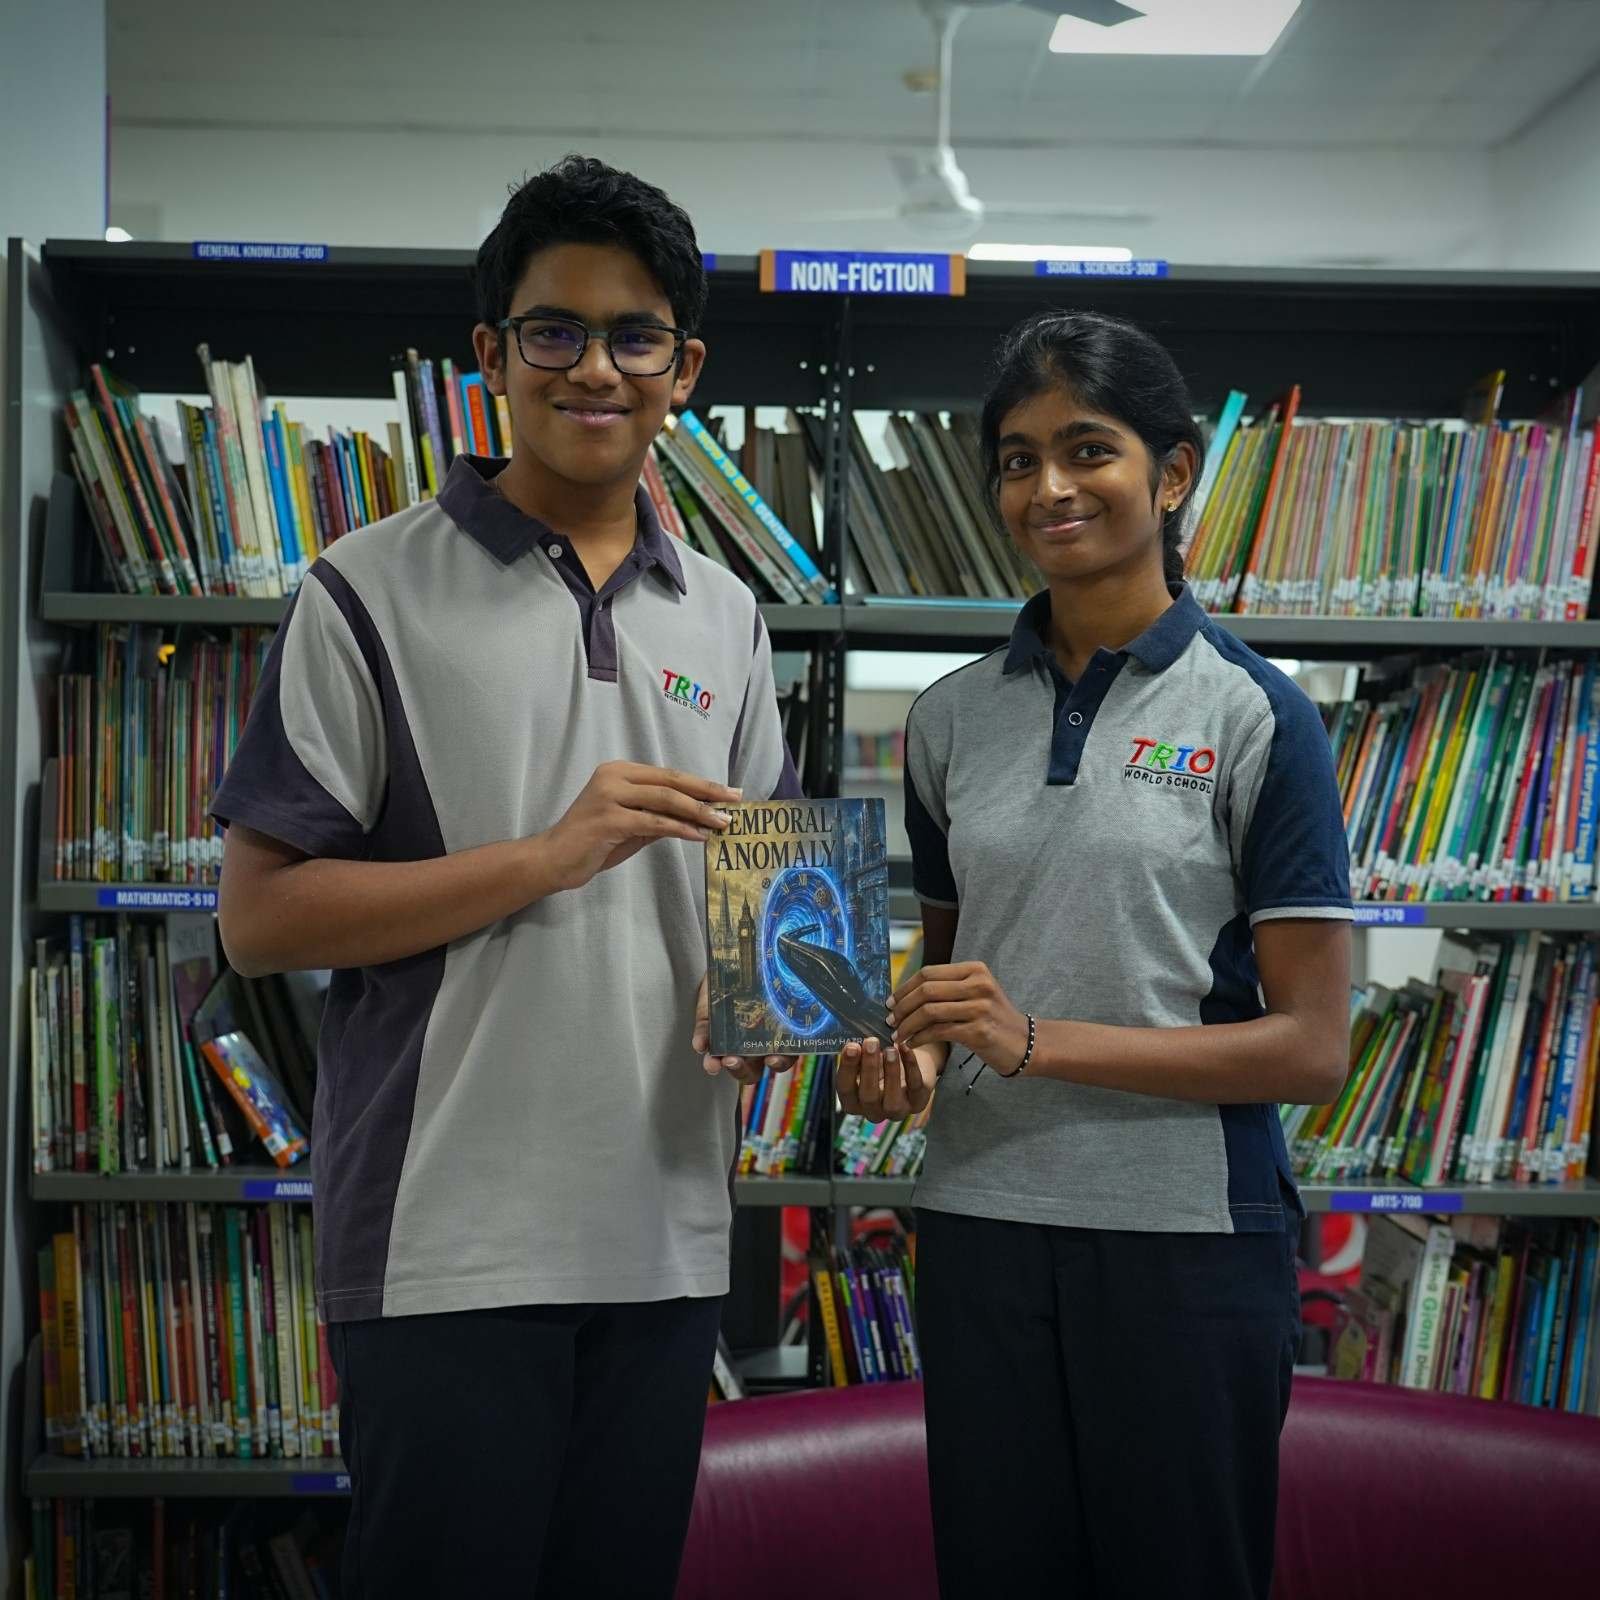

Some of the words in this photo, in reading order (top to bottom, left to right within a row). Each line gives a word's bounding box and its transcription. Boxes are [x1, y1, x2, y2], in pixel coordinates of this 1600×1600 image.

[197, 243, 241, 258] GENERAL
[791, 261, 935, 293] NON-FICTION
[1046, 260, 1082, 275] SOCIAL
[662, 668, 711, 711] TRIO
[1128, 736, 1216, 775] TRIO
[1123, 769, 1163, 785] WORLD
[1165, 775, 1212, 795] SCHOOL
[715, 839, 837, 871] ANOMALY
[117, 890, 216, 907] MATHEMATICS-510
[743, 1041, 764, 1049] ISHA
[765, 1041, 773, 1049] K
[773, 1040, 796, 1048] RAJU
[803, 1037, 837, 1048] KRISHIV
[1371, 1193, 1424, 1209] ARTS-700
